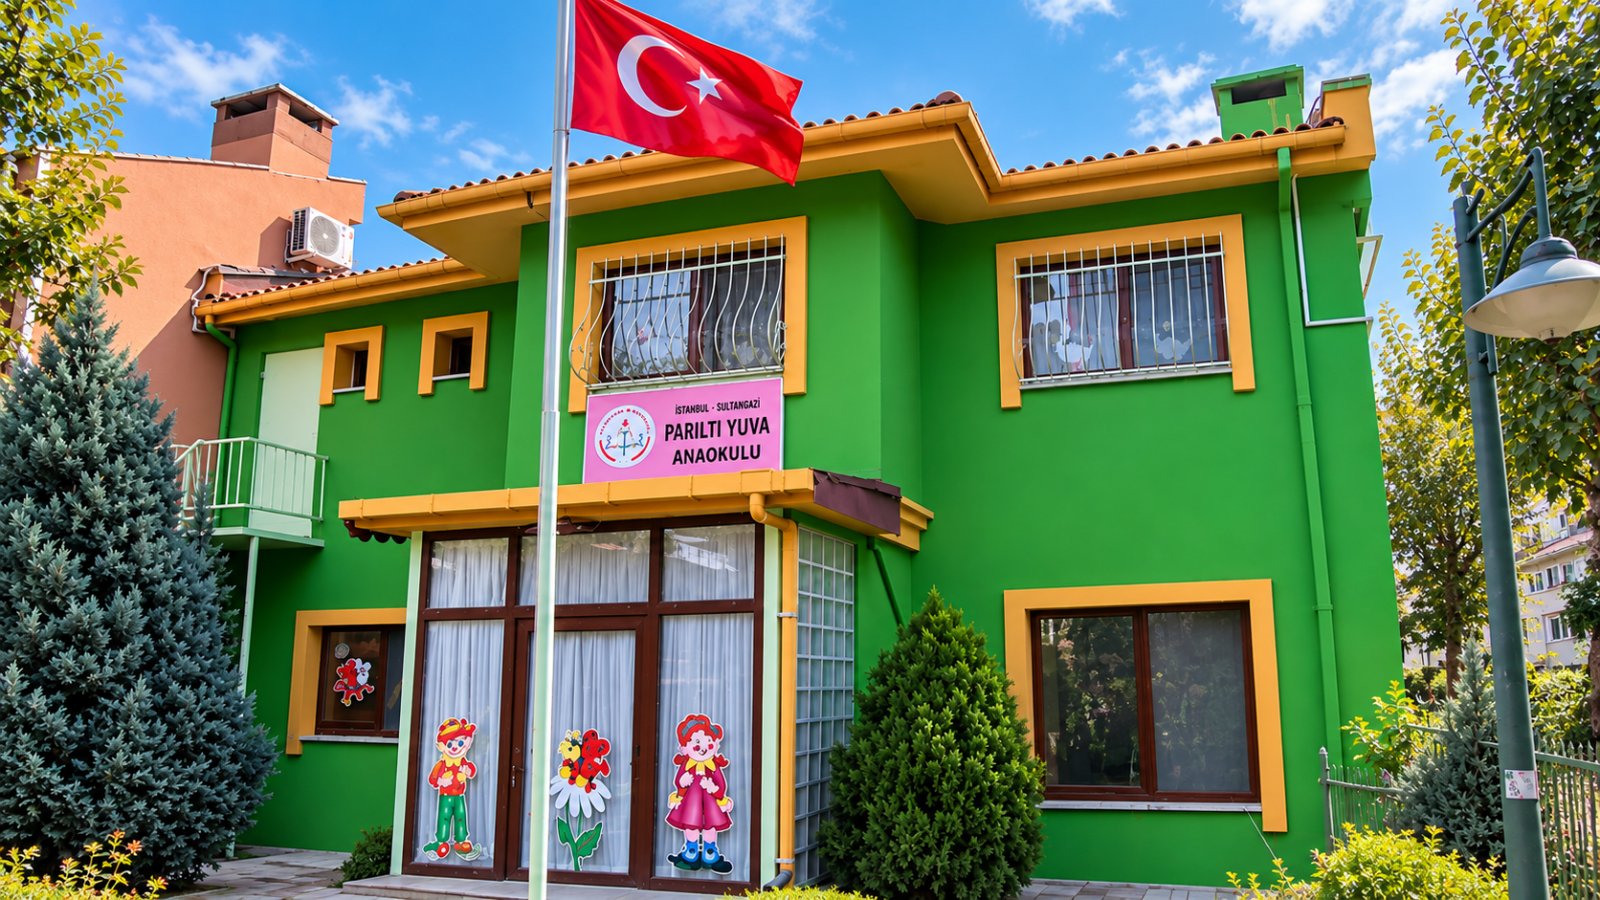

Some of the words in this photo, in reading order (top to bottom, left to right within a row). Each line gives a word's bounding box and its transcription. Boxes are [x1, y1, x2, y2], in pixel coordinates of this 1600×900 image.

[716, 398, 761, 412] SULTANGAZİ
[665, 420, 721, 442] PARILTI
[727, 417, 770, 437] YUVA
[672, 444, 761, 465] ANAOKULU
